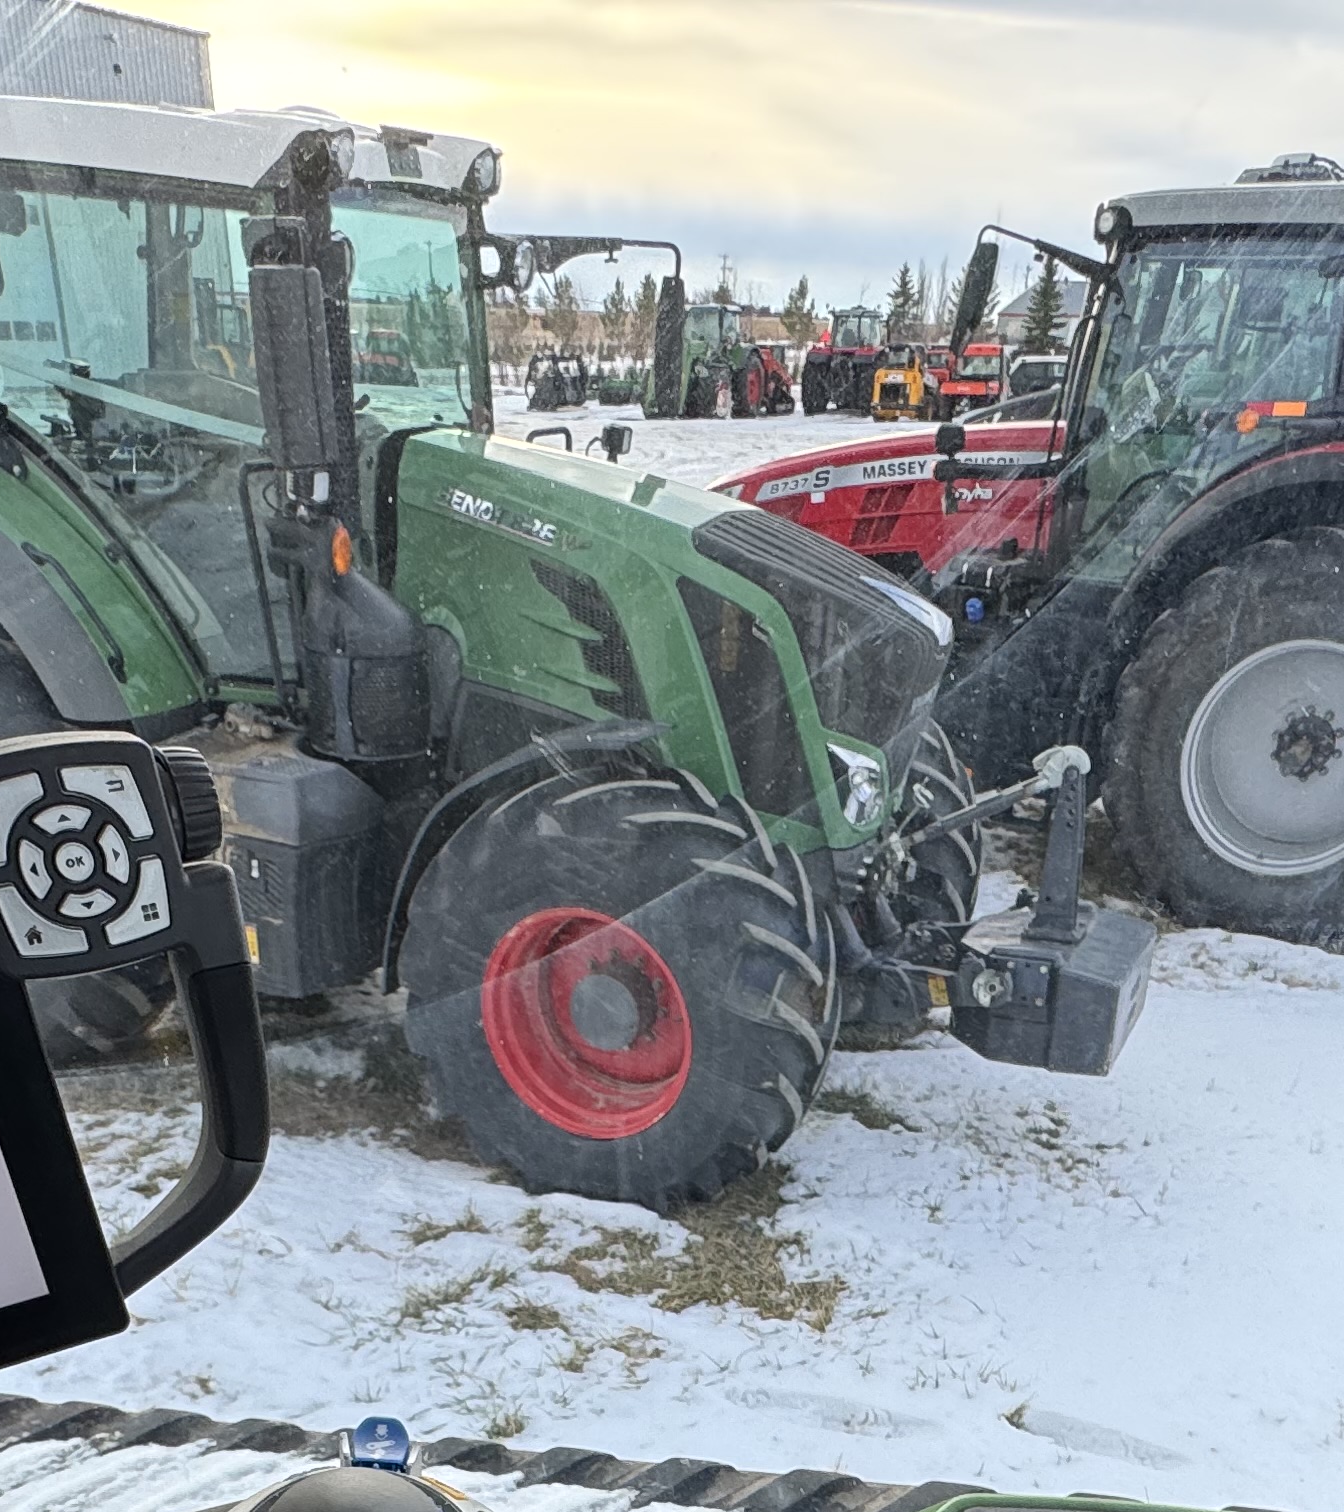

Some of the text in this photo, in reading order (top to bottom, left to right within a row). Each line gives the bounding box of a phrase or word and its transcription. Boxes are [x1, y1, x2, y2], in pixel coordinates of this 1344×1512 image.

[769, 459, 928, 495] 8737 S MASSEY
[65, 855, 86, 869] OK
